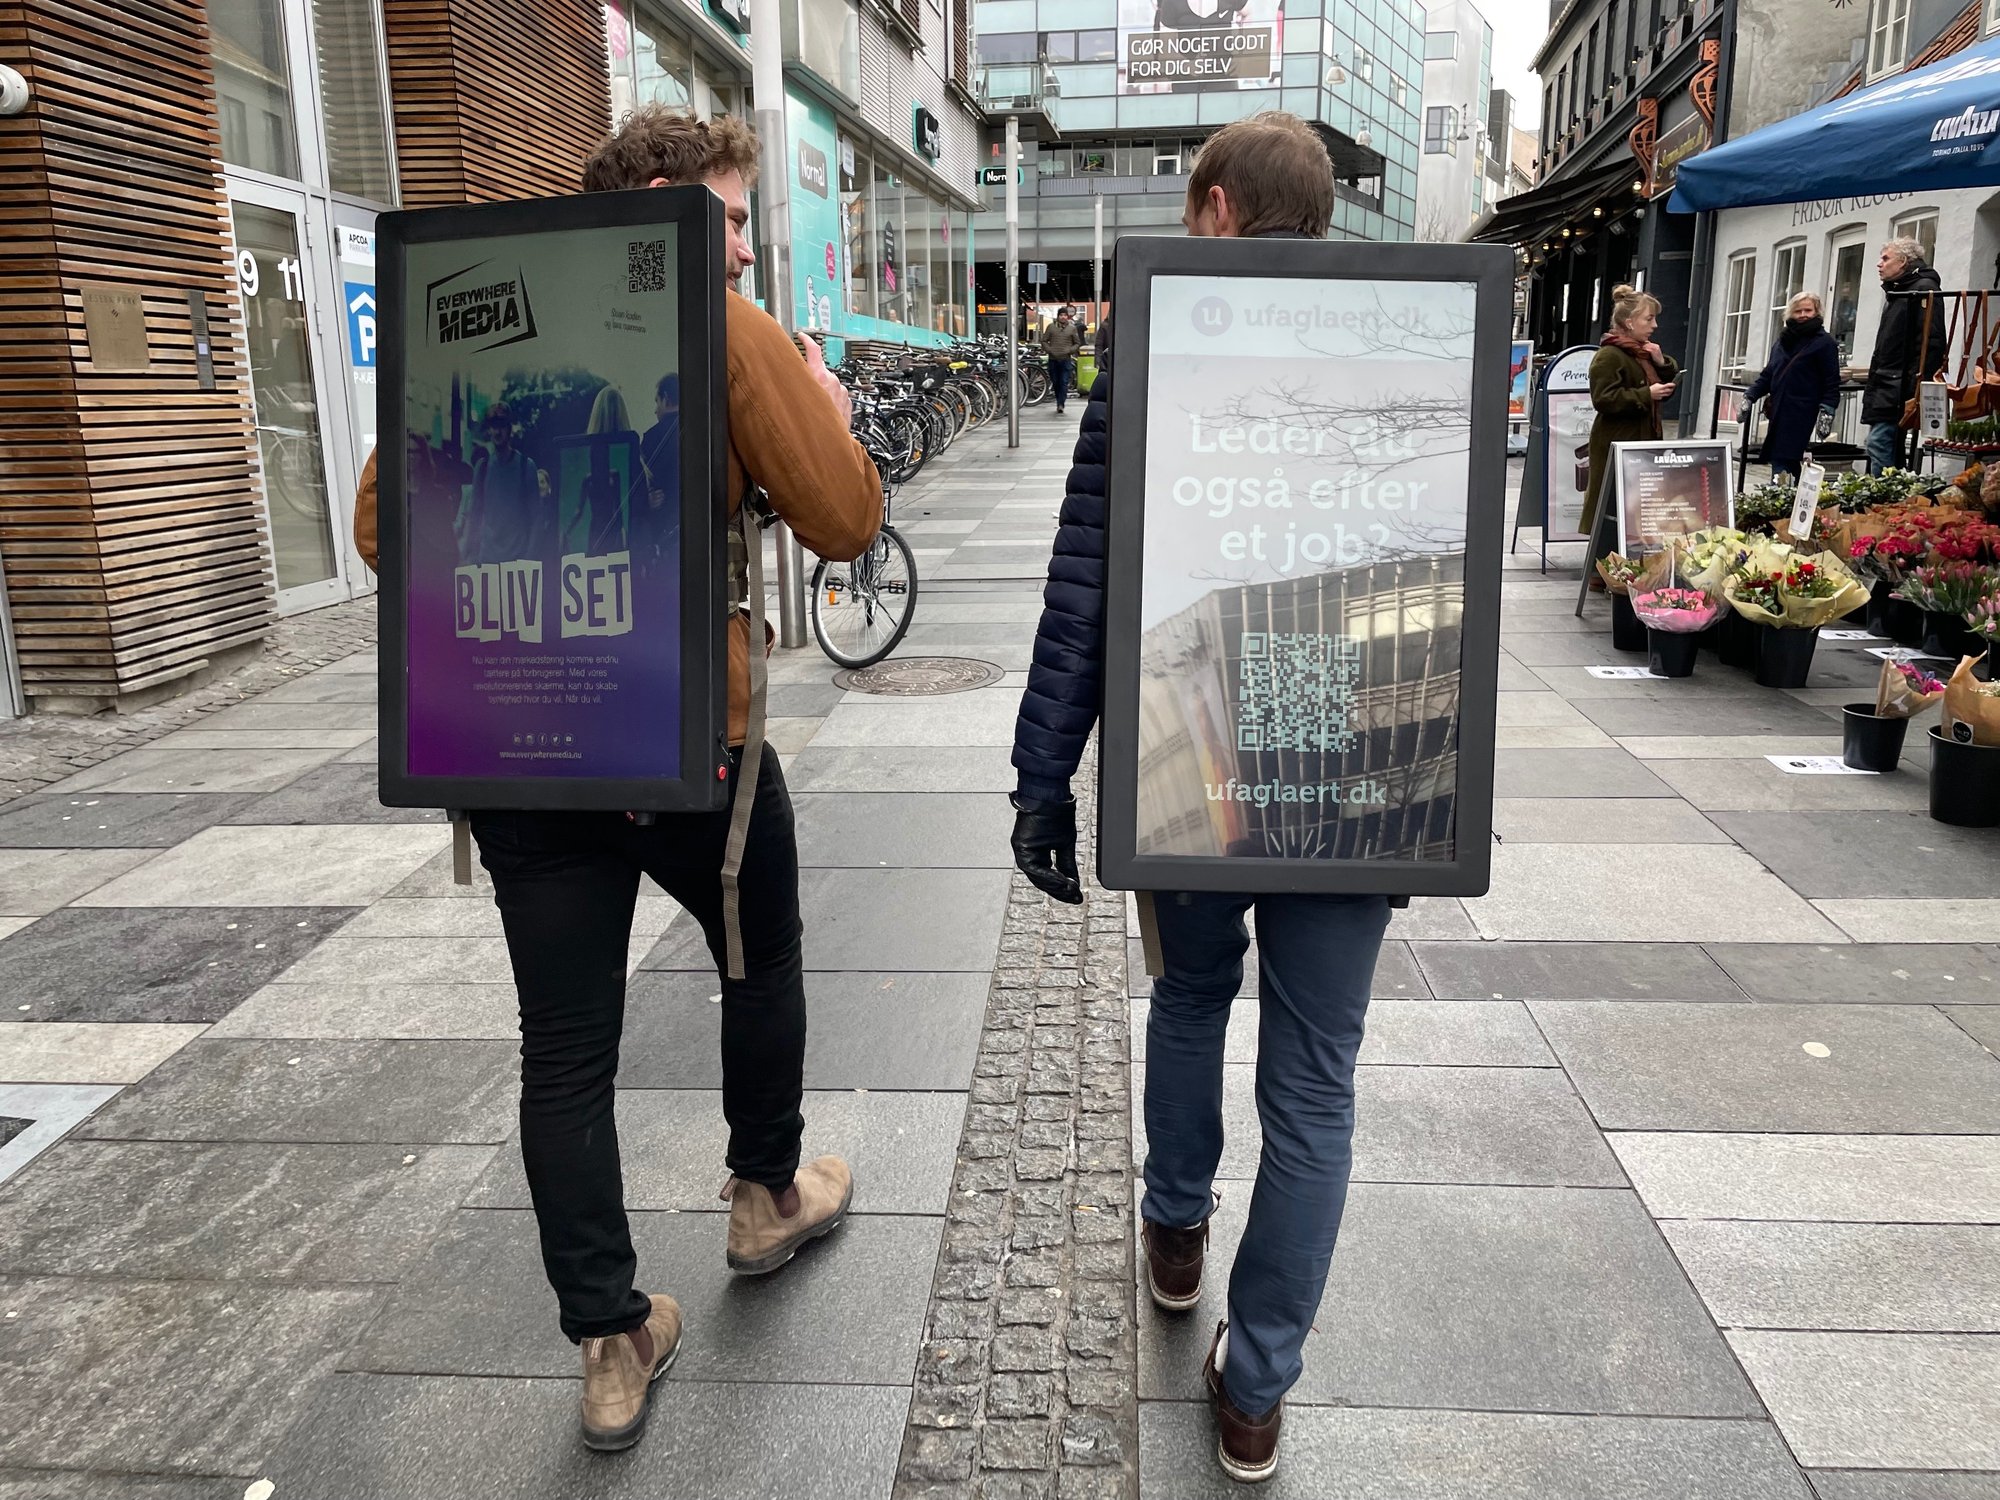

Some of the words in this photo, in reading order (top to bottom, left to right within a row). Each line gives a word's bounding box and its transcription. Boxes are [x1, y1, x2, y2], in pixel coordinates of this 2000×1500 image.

[1131, 39, 1164, 56] GØR
[1168, 36, 1220, 54] NOGET
[1224, 34, 1268, 51] GODT
[1131, 60, 1161, 77] FOR
[1165, 59, 1191, 76] DIG
[1194, 58, 1232, 75] SELV
[1930, 105, 2000, 141] LAVAZZA
[800, 150, 825, 187] Normal
[986, 170, 1006, 182] Norm
[349, 233, 369, 246] APCOA
[238, 250, 260, 297] 9
[278, 257, 303, 302] 11
[436, 280, 517, 311] EVERYWHERE
[439, 297, 521, 344] MEDIA
[1244, 303, 1429, 332] ufaglaert.dk
[357, 314, 376, 362] P
[1190, 413, 1327, 455] Leder
[1352, 415, 1420, 457] du
[1654, 452, 1694, 464] LAVAZZA
[1173, 467, 1293, 519] også
[1308, 469, 1429, 512] efter
[1220, 523, 1267, 562] et
[1280, 522, 1391, 573] job?
[456, 568, 540, 632] BLIV
[562, 563, 629, 628] SET
[511, 668, 520, 678] på
[569, 668, 586, 677] Med
[588, 669, 608, 677] vores
[566, 654, 594, 664] komme
[596, 654, 618, 664] endnu
[542, 694, 552, 704] du
[566, 694, 578, 704] Når
[581, 694, 591, 704] du
[568, 682, 582, 690] kan
[584, 682, 594, 690] du
[596, 681, 618, 690] skabe
[1205, 778, 1387, 808] ufaglaert.dk
